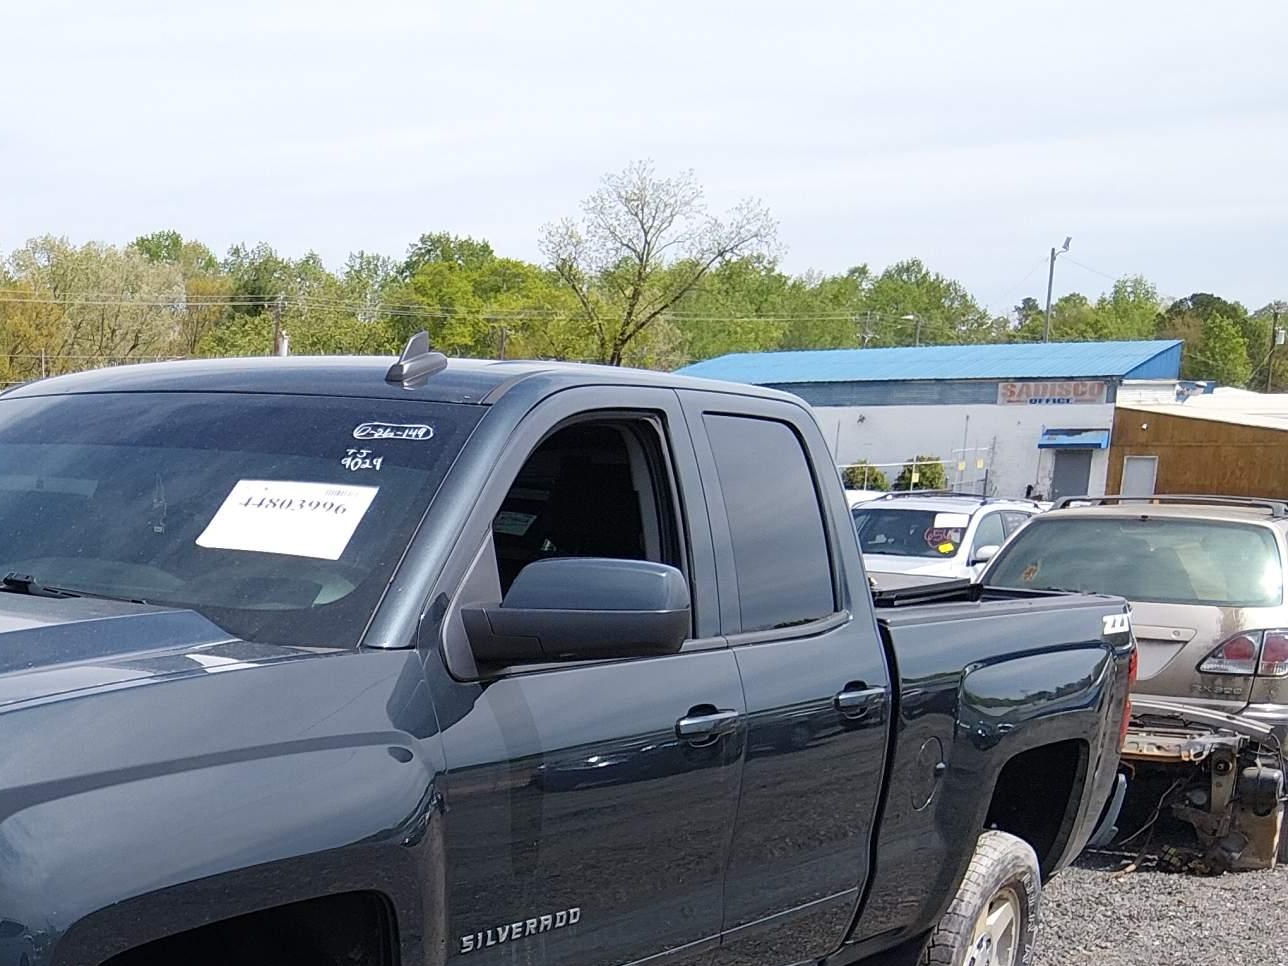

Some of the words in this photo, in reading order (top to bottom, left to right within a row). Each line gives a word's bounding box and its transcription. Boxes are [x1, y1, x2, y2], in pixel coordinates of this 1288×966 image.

[1000, 382, 1105, 398] SADISCO
[240, 496, 347, 514] 44803996
[460, 907, 581, 953] SILVERADO
